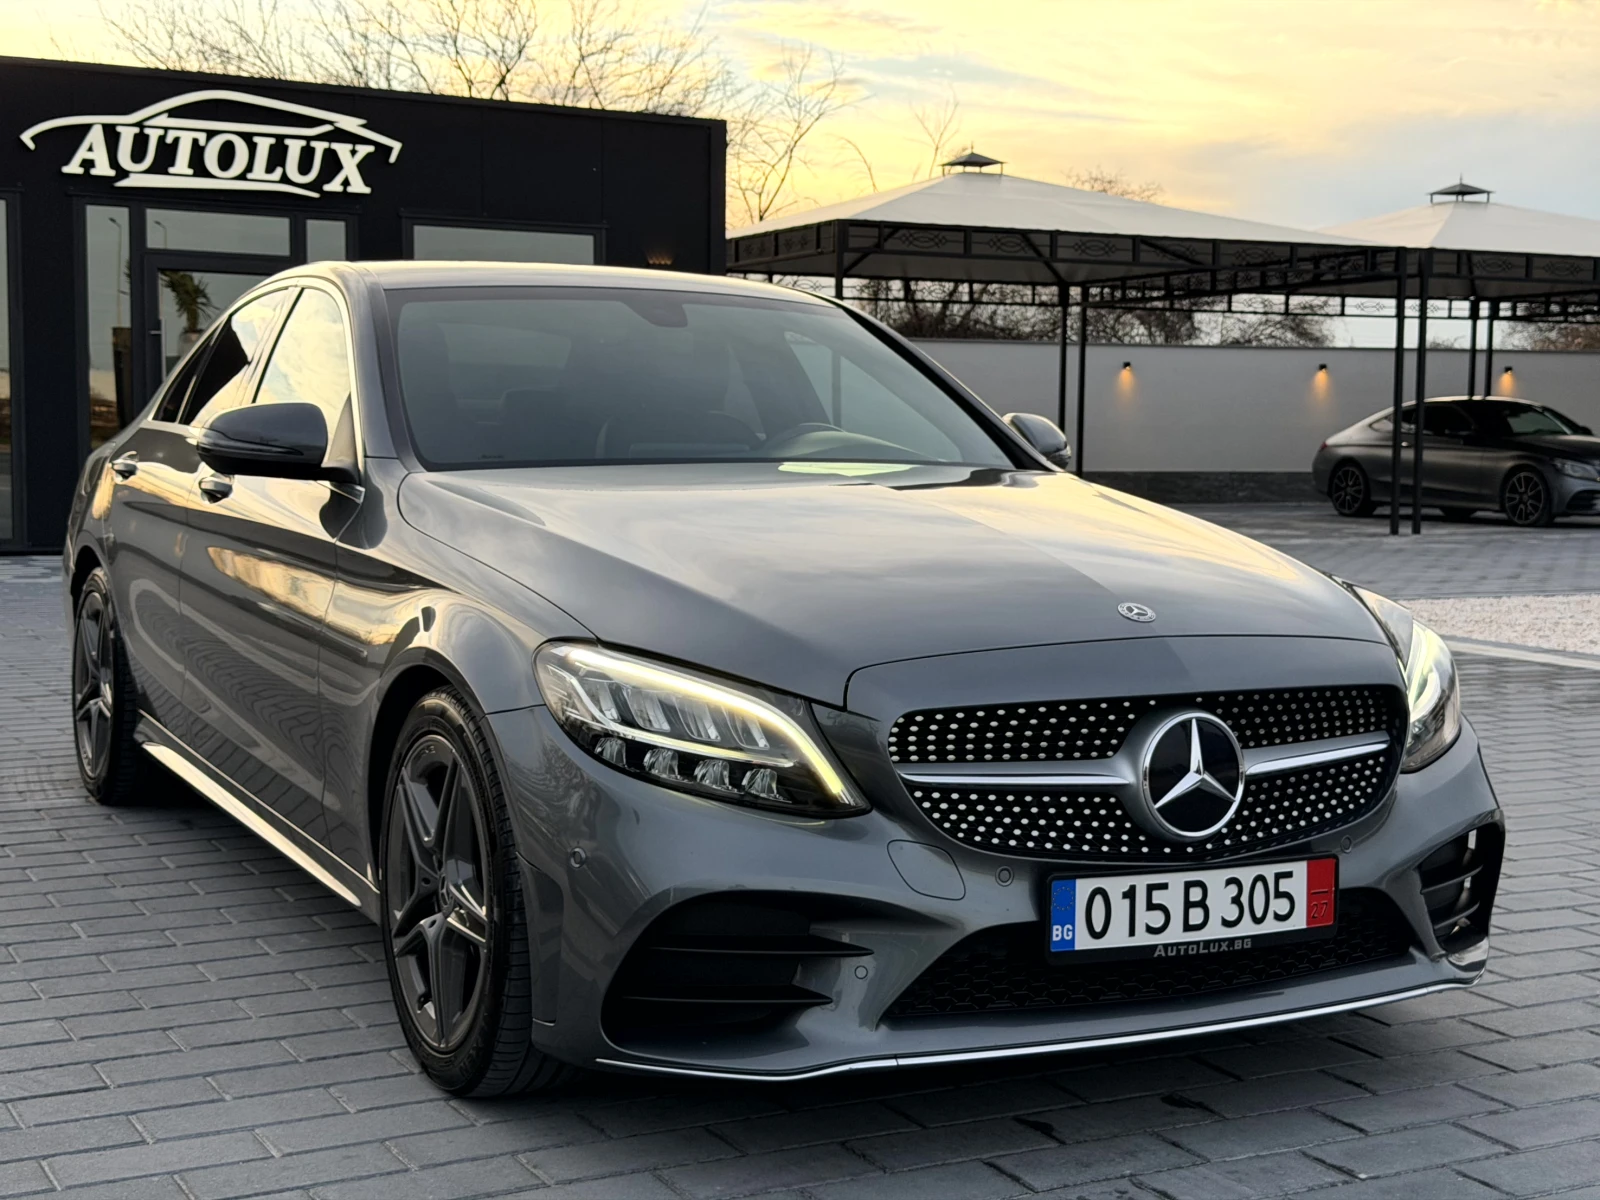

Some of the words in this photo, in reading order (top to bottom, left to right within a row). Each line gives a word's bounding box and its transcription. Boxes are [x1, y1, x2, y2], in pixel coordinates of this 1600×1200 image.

[61, 123, 376, 195] AUTOLUX
[1310, 900, 1328, 919] 27
[1052, 923, 1074, 941] BG
